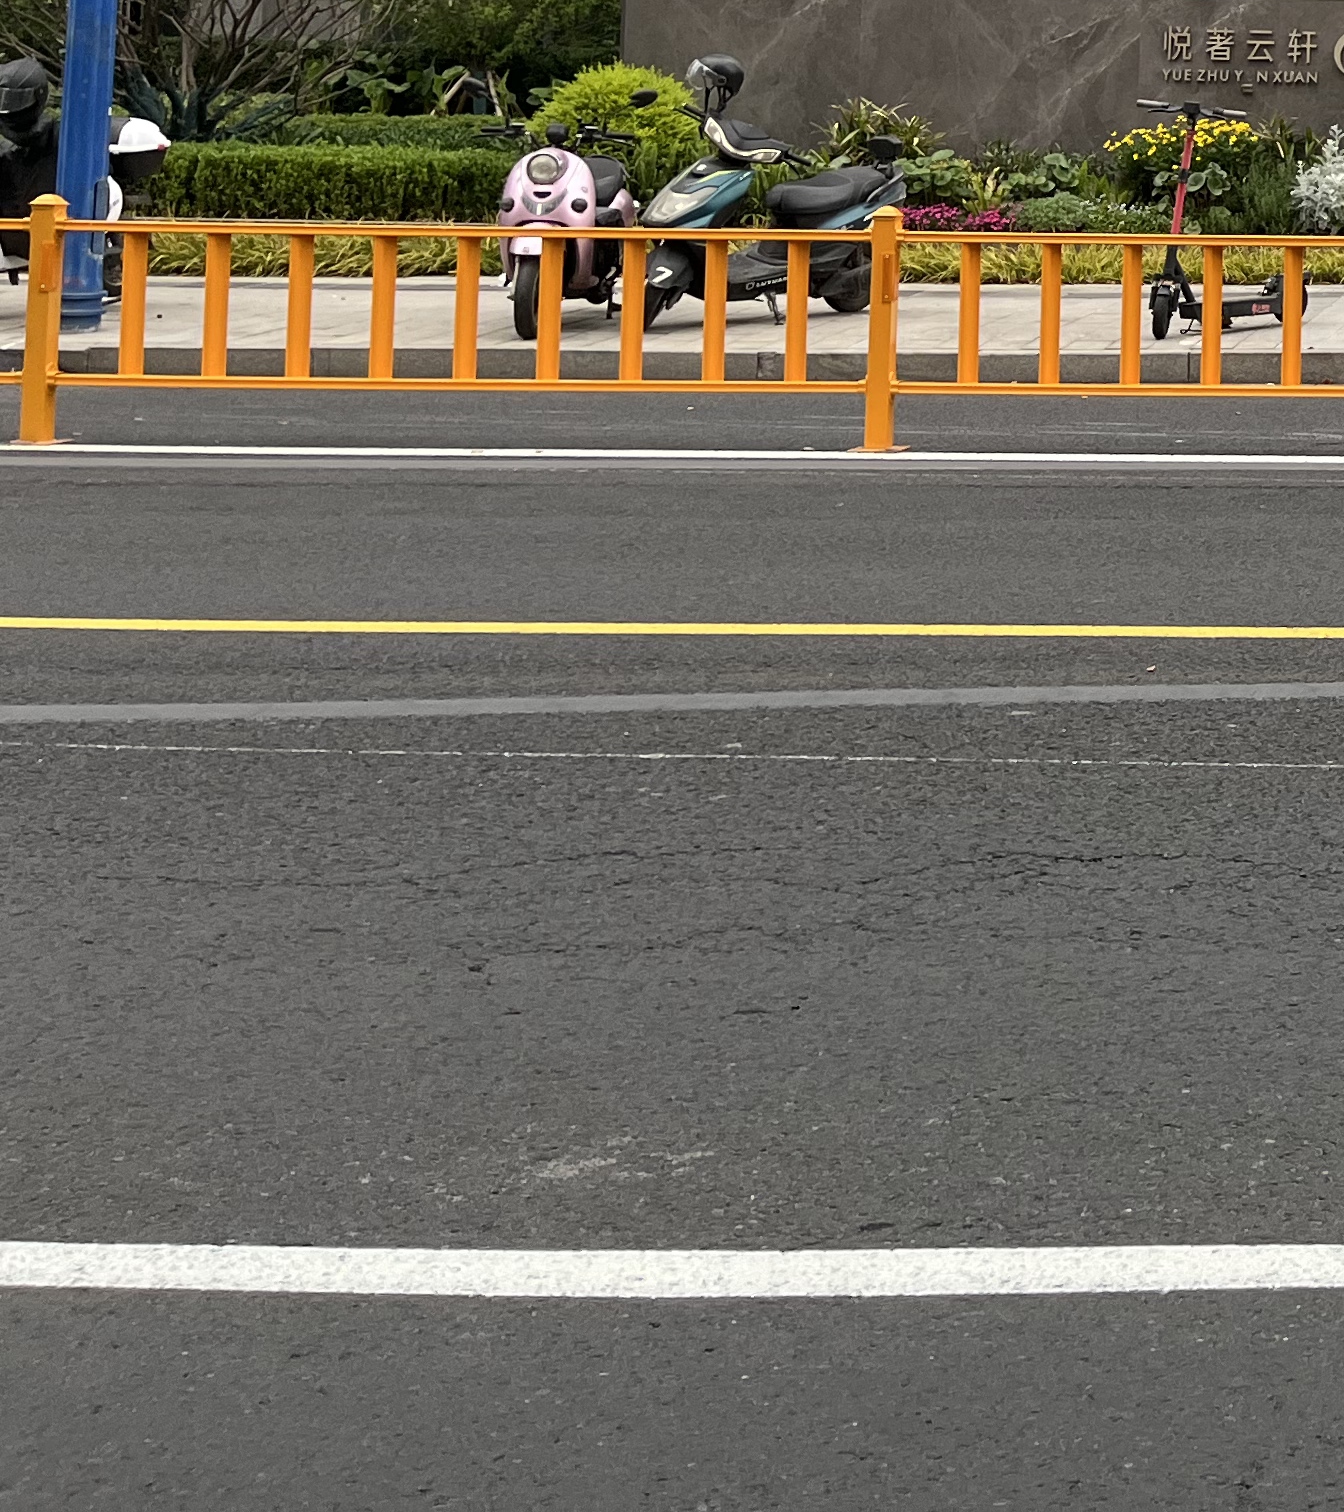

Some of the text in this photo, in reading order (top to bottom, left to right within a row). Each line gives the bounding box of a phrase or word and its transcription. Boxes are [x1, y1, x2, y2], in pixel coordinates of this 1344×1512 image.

[1163, 25, 1317, 64] 悦著云轩
[1162, 68, 1192, 82] YUE
[1196, 69, 1230, 82] ZHU
